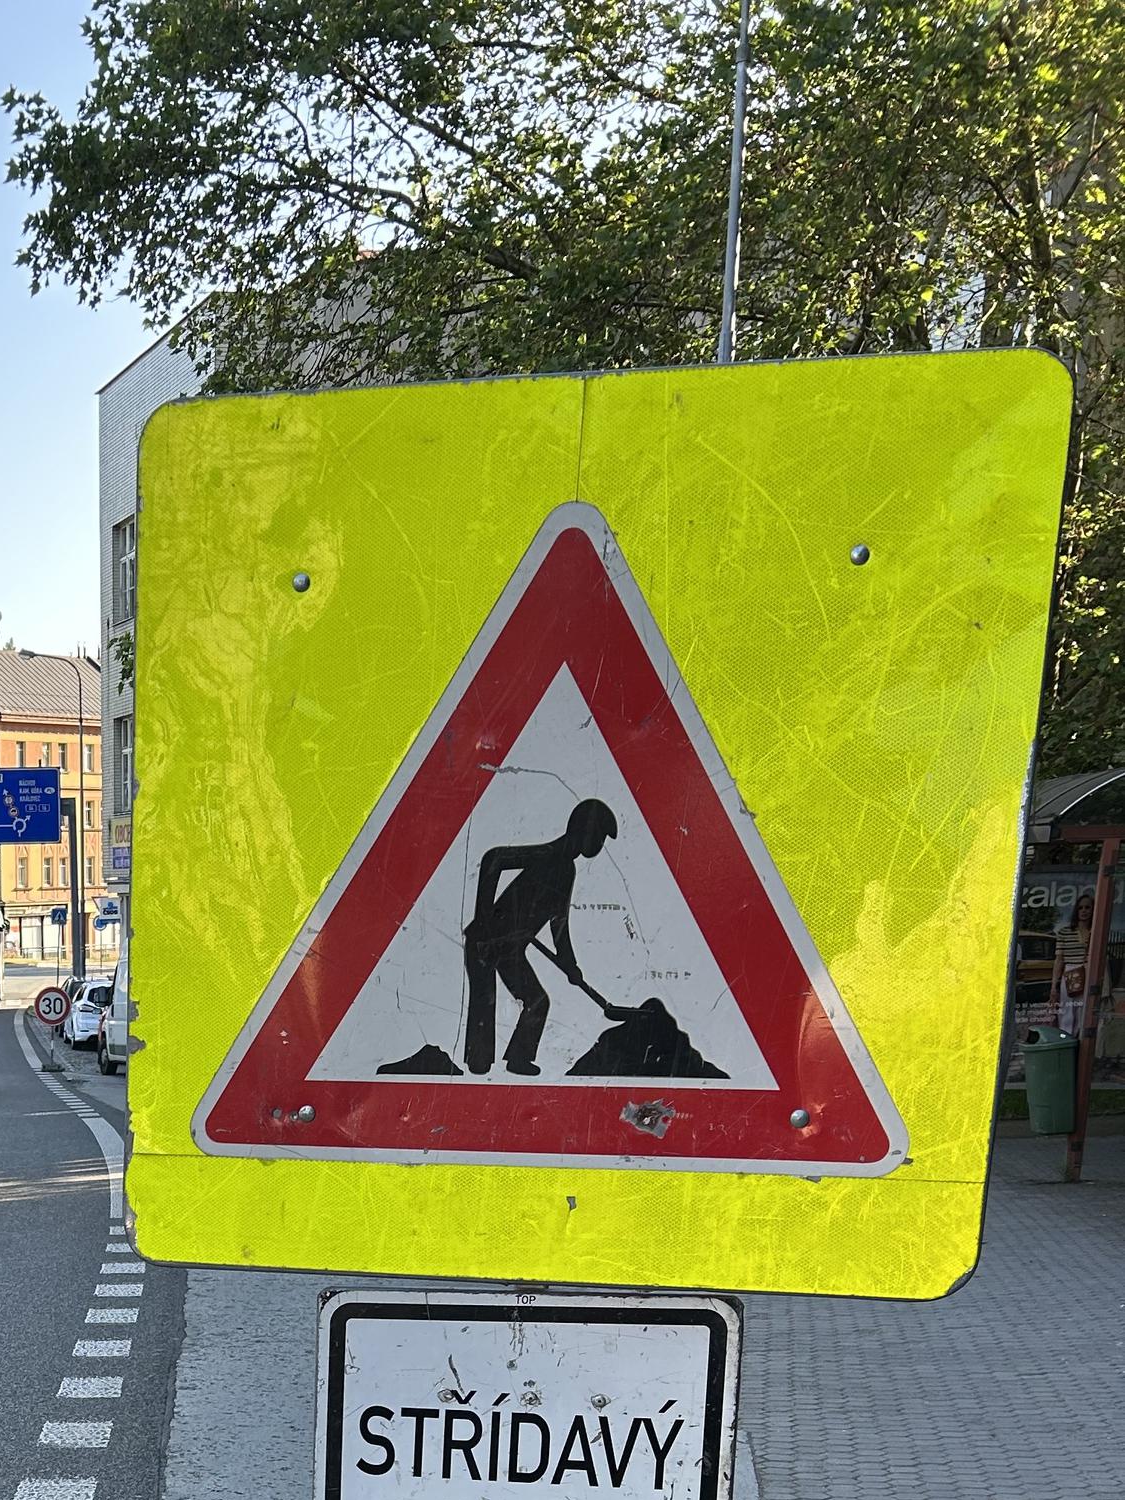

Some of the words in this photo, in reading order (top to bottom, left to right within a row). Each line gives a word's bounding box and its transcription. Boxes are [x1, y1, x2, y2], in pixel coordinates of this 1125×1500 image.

[42, 997, 63, 1014] 30
[515, 1294, 536, 1304] TOP
[356, 1389, 685, 1490] STŘÍDAVÝ
